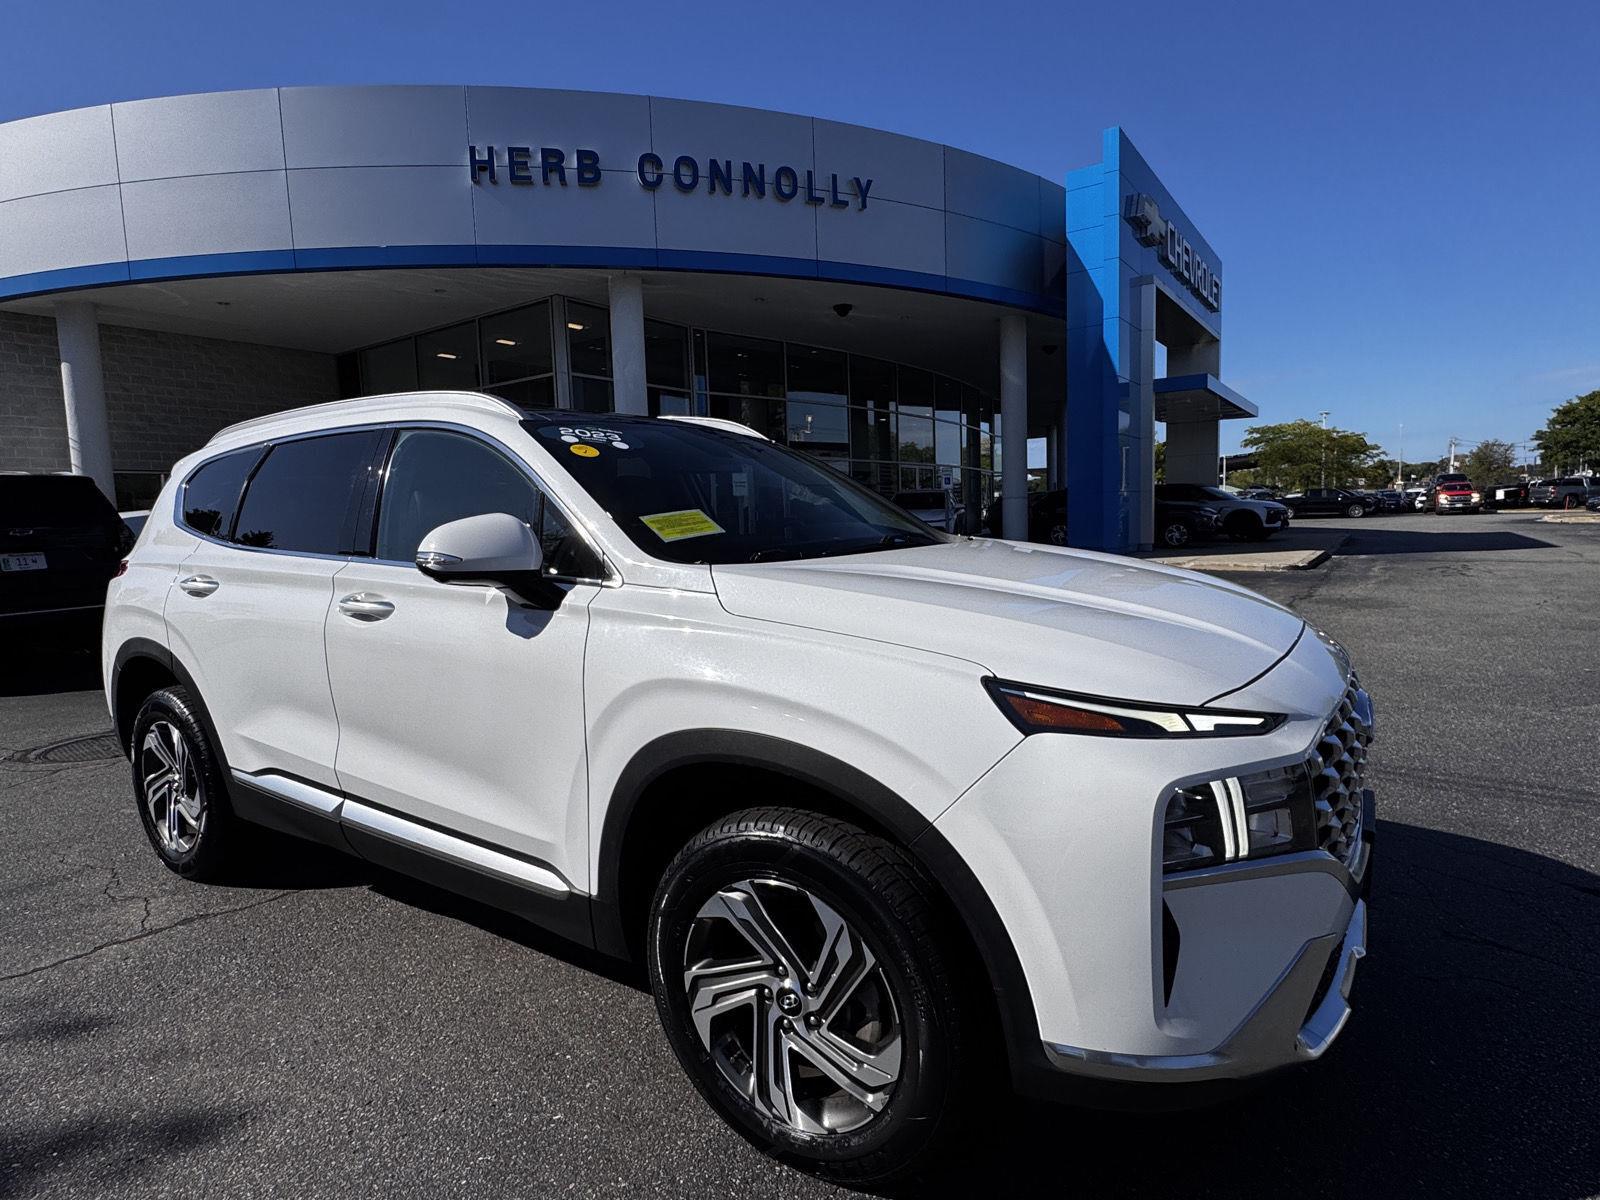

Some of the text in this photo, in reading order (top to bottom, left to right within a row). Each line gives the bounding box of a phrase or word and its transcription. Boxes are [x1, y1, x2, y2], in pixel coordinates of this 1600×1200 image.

[469, 145, 873, 210] HERB CONNOLLY
[558, 427, 622, 441] 2023
